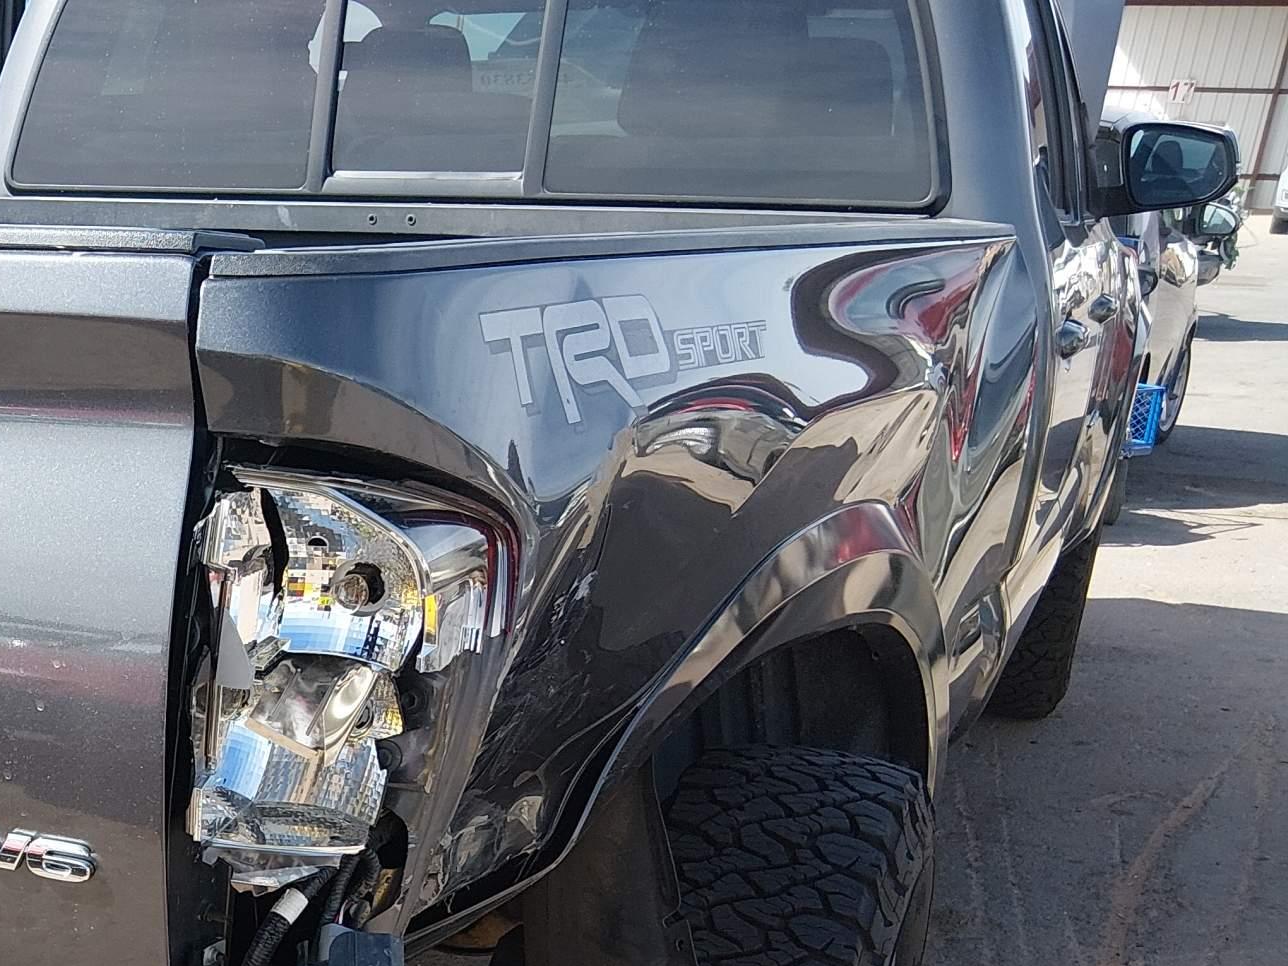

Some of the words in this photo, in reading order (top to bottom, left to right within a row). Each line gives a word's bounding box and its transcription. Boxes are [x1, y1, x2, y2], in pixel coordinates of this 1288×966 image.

[1171, 81, 1195, 102] 17
[478, 294, 672, 426] TRD
[673, 320, 768, 371] SPORT
